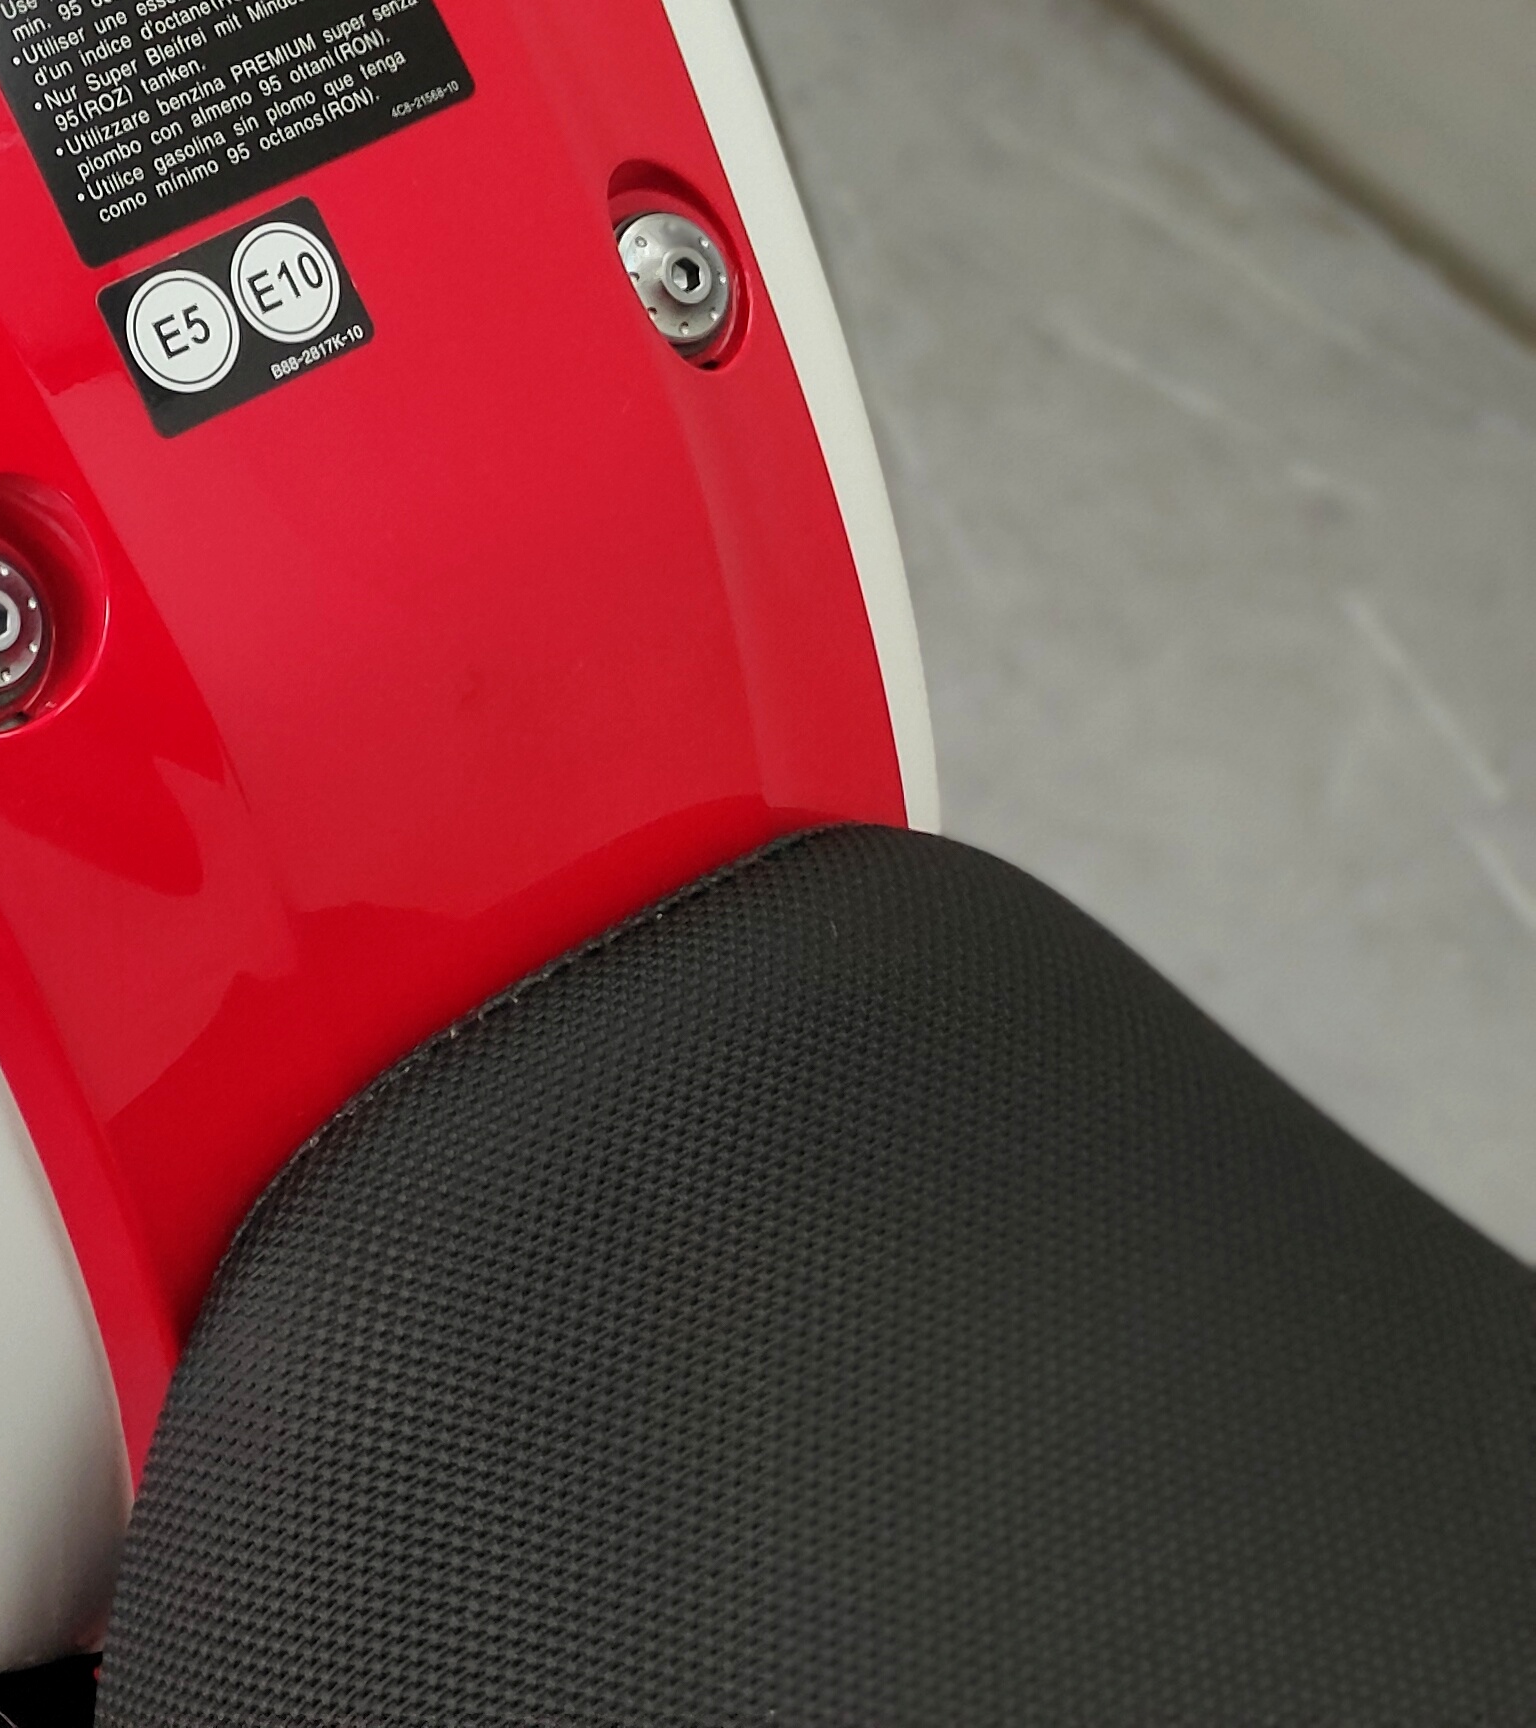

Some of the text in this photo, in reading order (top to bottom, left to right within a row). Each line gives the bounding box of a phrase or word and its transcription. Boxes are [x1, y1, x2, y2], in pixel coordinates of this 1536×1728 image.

[11, 13, 52, 43] min.
[23, 26, 87, 69] Utiliser
[93, 10, 128, 36] une
[33, 59, 74, 87] d'un
[77, 34, 133, 68] indice
[43, 82, 79, 112] Nur
[85, 58, 138, 92] Super
[143, 26, 208, 68] Bleifrei
[213, 11, 243, 39] mit
[64, 109, 151, 156] Utilizzare
[155, 77, 227, 117] benzina
[229, 32, 317, 86] PREMIUM
[322, 13, 367, 44] super
[139, 59, 207, 96] tanken.
[86, 166, 145, 201] Utilice
[153, 130, 227, 177] gasolina
[264, 90, 316, 128] plomo
[323, 73, 355, 99] que
[358, 50, 407, 81] tenga
[150, 121, 184, 146] con
[190, 90, 253, 129] almeno
[258, 73, 283, 97] 95
[99, 191, 148, 223] como
[154, 159, 220, 199] mínimo
[226, 141, 251, 166] 95
[246, 251, 324, 314] E10
[152, 303, 211, 360] E5
[270, 324, 364, 380] B88-2817K-10
